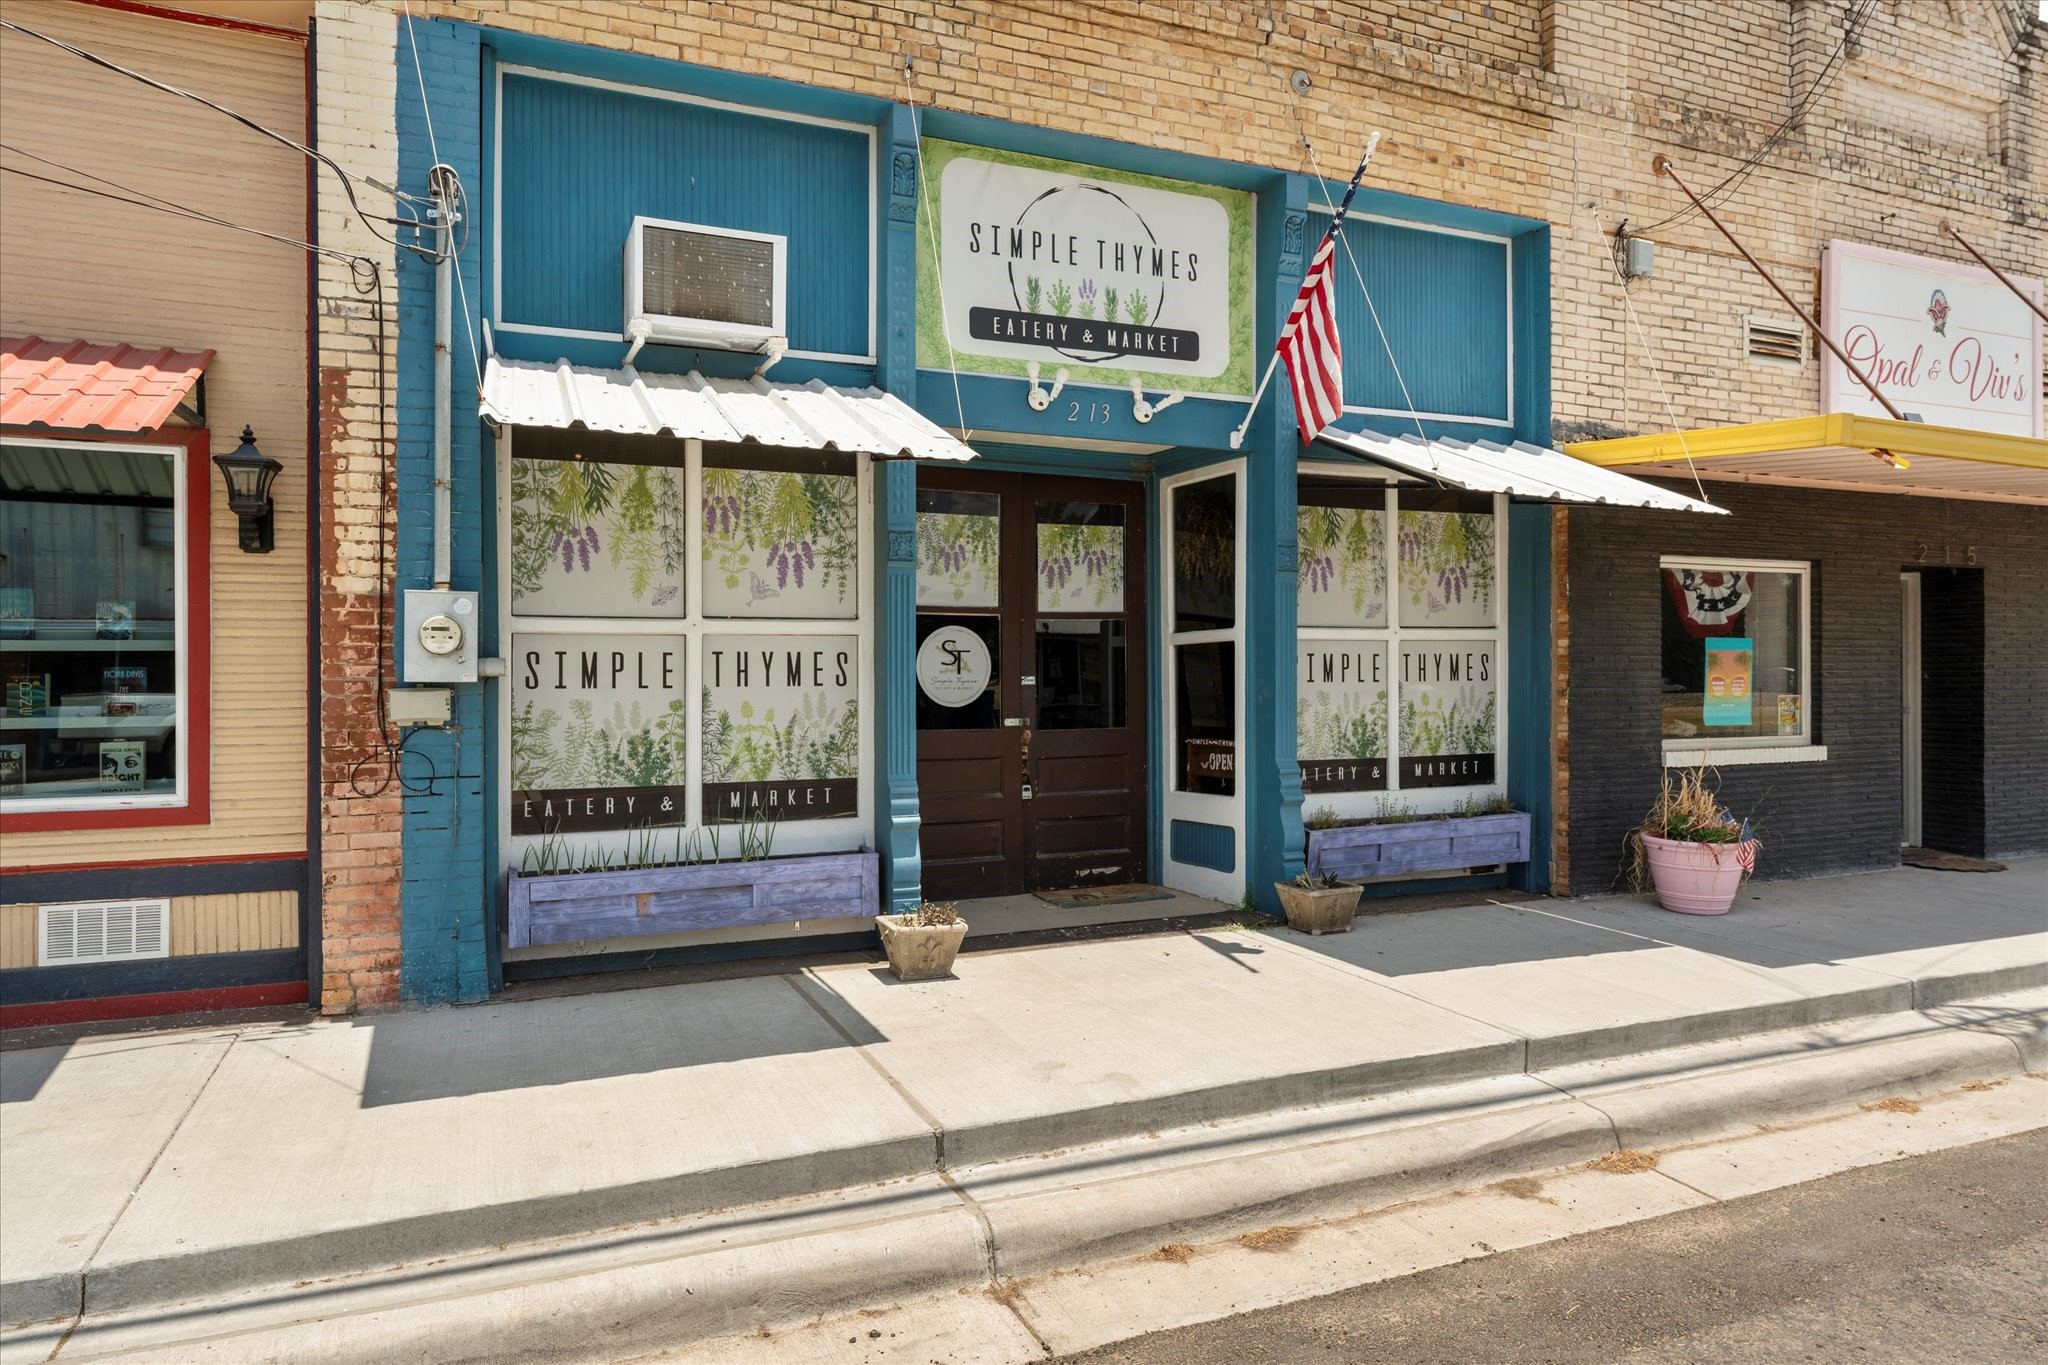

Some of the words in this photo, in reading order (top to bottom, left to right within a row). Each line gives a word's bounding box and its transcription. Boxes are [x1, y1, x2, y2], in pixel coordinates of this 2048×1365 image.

[970, 222, 1077, 266] SIMPLE
[1097, 239, 1198, 282] THYMES
[993, 316, 1068, 341] EATERY
[1082, 329, 1093, 344] &
[1107, 329, 1179, 354] MARKET
[1844, 324, 1923, 402] Opal
[1928, 359, 1942, 380] &
[1950, 337, 2028, 402] Viv's
[1067, 401, 1110, 424] 213
[1917, 544, 1977, 566] 215
[126, 670, 144, 678] DAVIS
[525, 651, 674, 690] SIMPLE
[711, 651, 849, 688] THYMES
[1297, 653, 1380, 683] IMPLE
[1403, 653, 1489, 682] THYMES
[19, 682, 33, 716] DUNE
[1209, 752, 1233, 771] OPEN
[1301, 766, 1357, 782] ATERY
[1371, 767, 1380, 779] &
[1415, 760, 1479, 777] MARKET
[524, 796, 635, 819] EATERY
[660, 796, 673, 812] &
[730, 787, 832, 809] MARKET
